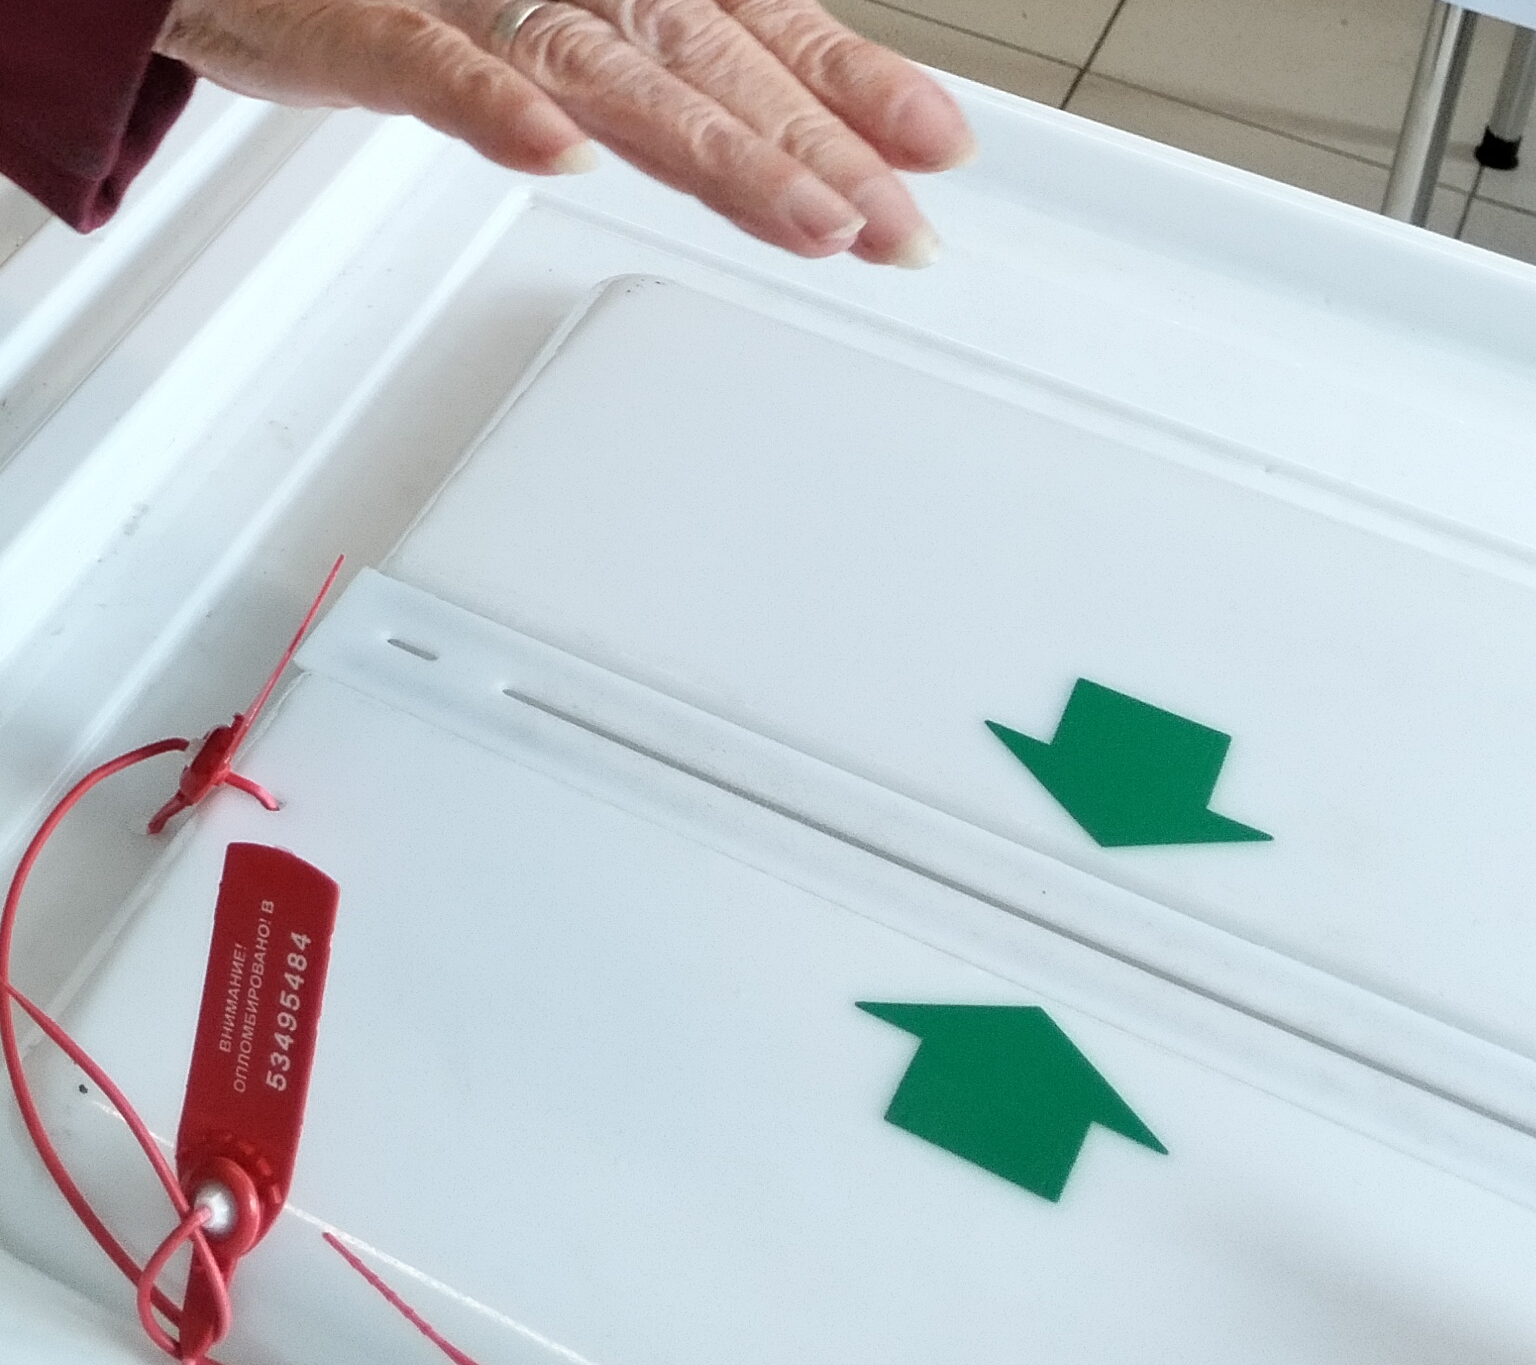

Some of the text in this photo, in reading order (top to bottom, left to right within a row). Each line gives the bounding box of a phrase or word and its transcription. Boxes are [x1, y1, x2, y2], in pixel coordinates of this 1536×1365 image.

[219, 943, 247, 1053] ВНИМАНИЕ!
[233, 918, 272, 1094] ОПЛОМБИРОВАНО!
[266, 931, 312, 1092] 53495484
